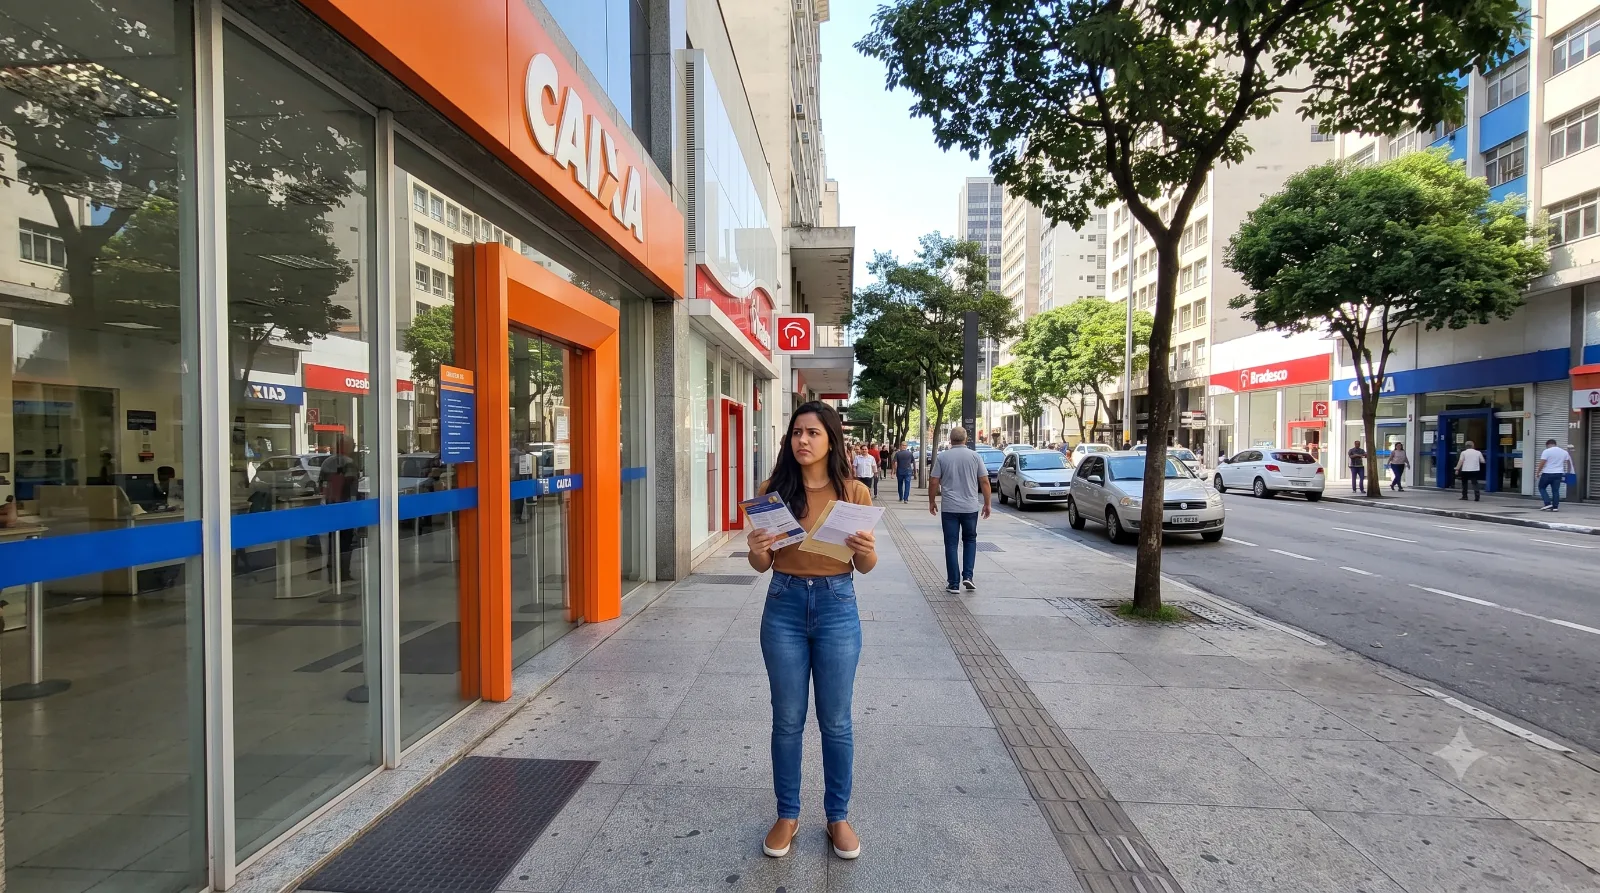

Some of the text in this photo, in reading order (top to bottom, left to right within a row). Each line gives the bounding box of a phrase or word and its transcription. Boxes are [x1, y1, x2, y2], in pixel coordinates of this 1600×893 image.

[525, 52, 644, 243] CAIXA
[1250, 368, 1288, 385] Bradesco
[557, 478, 572, 489] CAIXA
